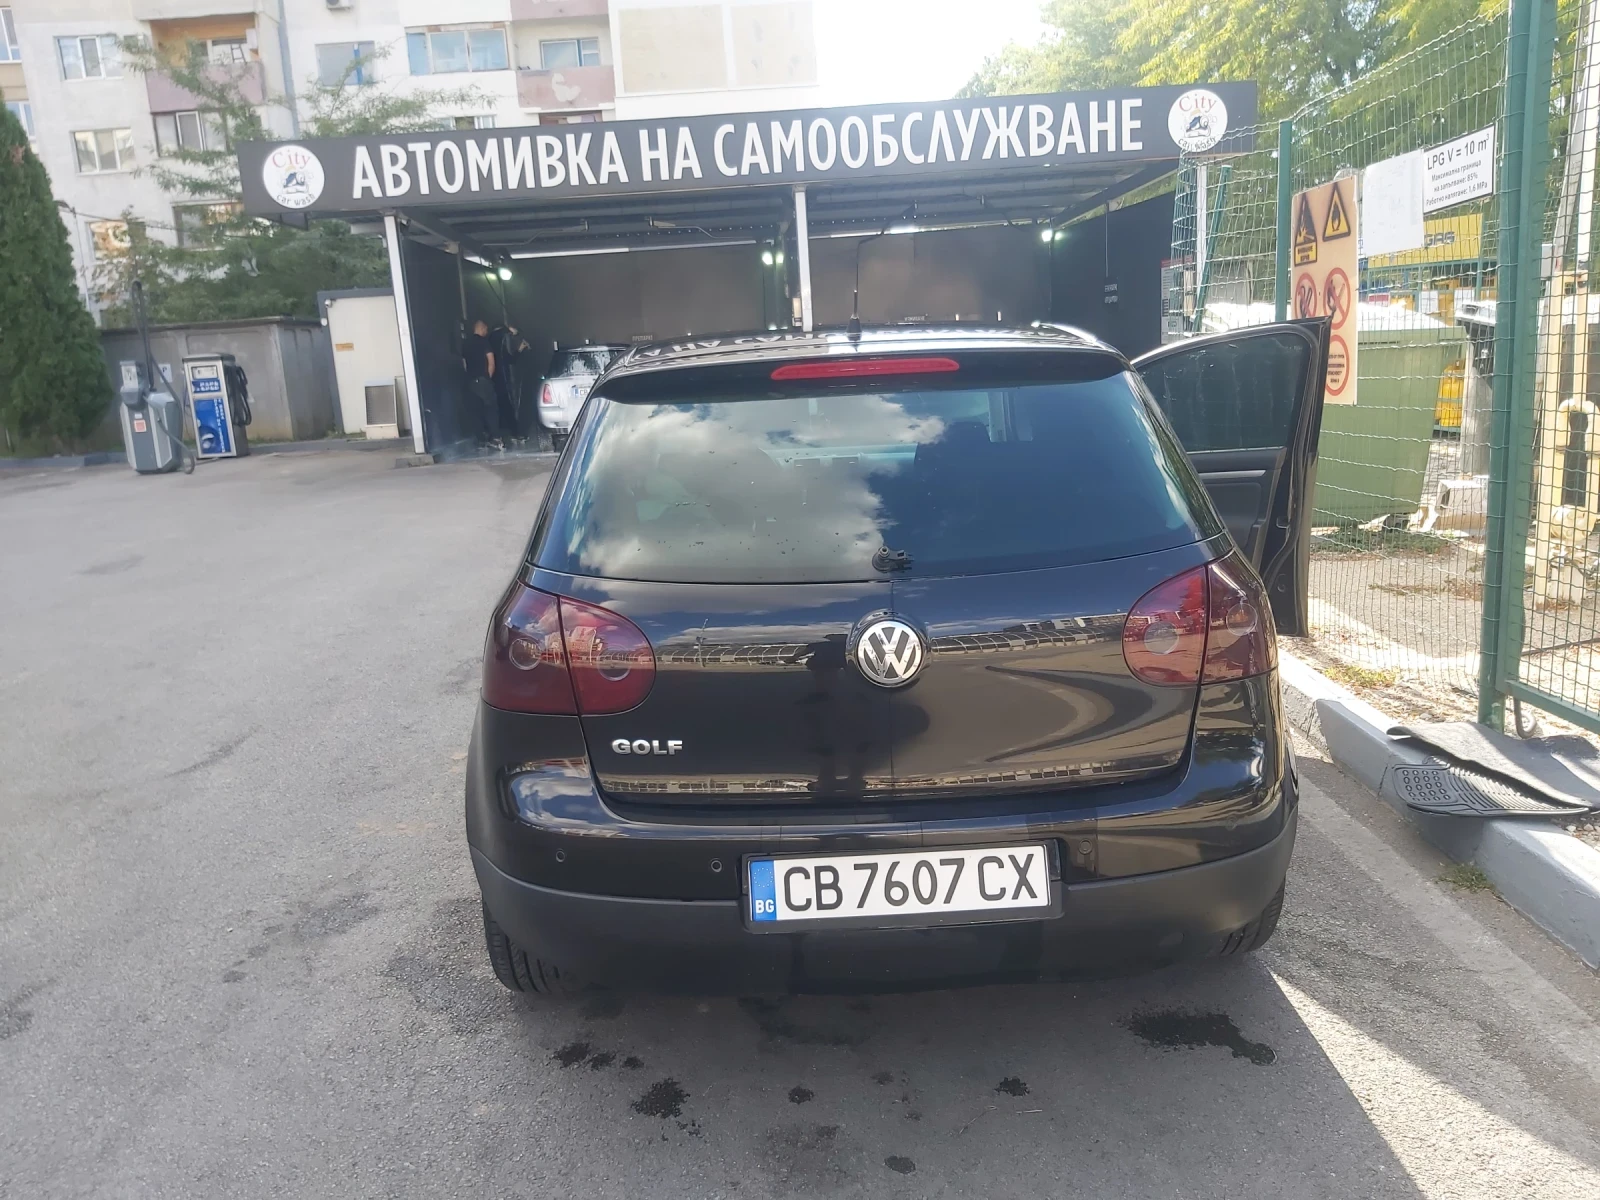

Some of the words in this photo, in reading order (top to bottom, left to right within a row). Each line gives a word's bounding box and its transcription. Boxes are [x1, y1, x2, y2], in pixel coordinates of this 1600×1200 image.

[1178, 93, 1217, 113] City
[272, 148, 311, 169] City
[352, 130, 629, 199] АВТОМИВКА
[638, 126, 703, 182] НА
[713, 98, 1144, 177] САМООБСЛУЖВАНЕ
[1427, 152, 1445, 170] LPG
[1447, 148, 1454, 162] V
[1456, 149, 1462, 157] =
[1464, 140, 1475, 156] 10
[1431, 167, 1460, 182] Максимална
[1460, 160, 1481, 174] граница
[1467, 172, 1478, 182] 85%
[276, 194, 291, 205] car
[294, 193, 316, 206] wash
[1426, 195, 1444, 206] Работно
[611, 738, 684, 756] GOLF
[783, 865, 843, 912] CB
[853, 858, 965, 909] 7607
[977, 853, 1038, 902] CX
[755, 899, 775, 914] BG
